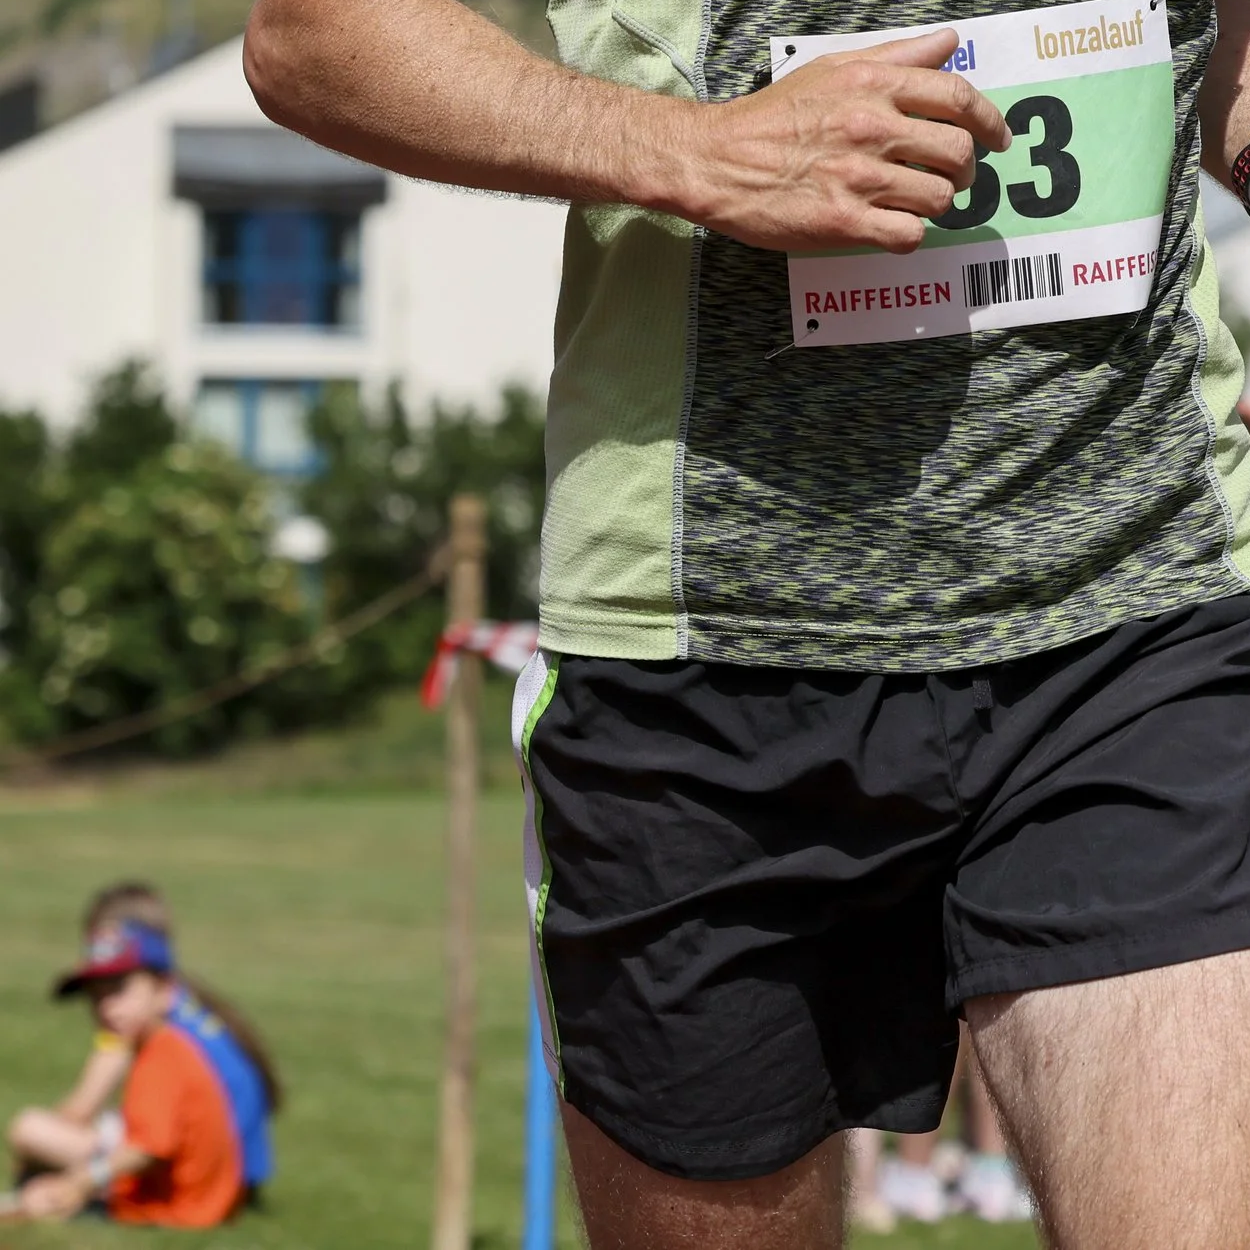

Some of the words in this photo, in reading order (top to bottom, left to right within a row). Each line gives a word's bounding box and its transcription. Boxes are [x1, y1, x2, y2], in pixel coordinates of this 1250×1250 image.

[1034, 10, 1145, 61] lonzalauf
[1073, 250, 1158, 286] RAIFFEIS
[805, 281, 951, 314] RAIFFEISEN
